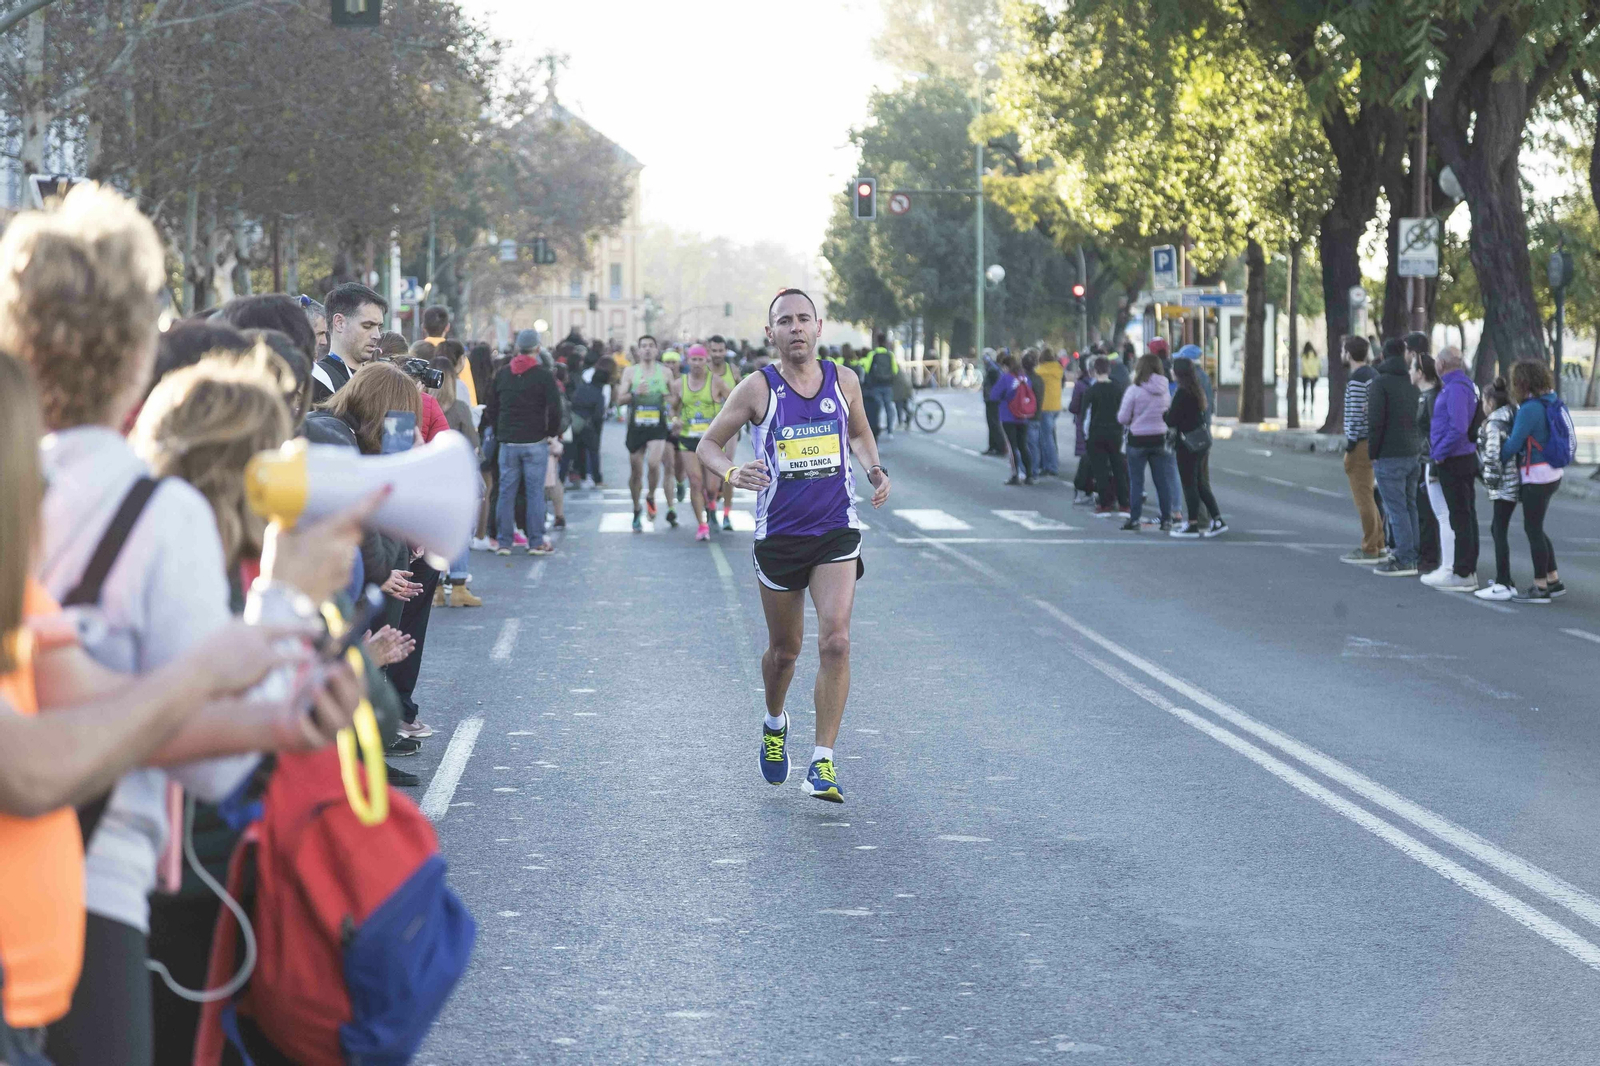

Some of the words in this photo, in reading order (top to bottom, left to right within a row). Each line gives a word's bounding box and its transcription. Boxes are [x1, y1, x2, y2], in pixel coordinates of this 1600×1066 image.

[1158, 252, 1169, 269] P
[796, 425, 831, 436] ZURICH
[801, 446, 820, 455] 450
[790, 460, 808, 469] ENZO
[810, 458, 832, 467] TANCA
